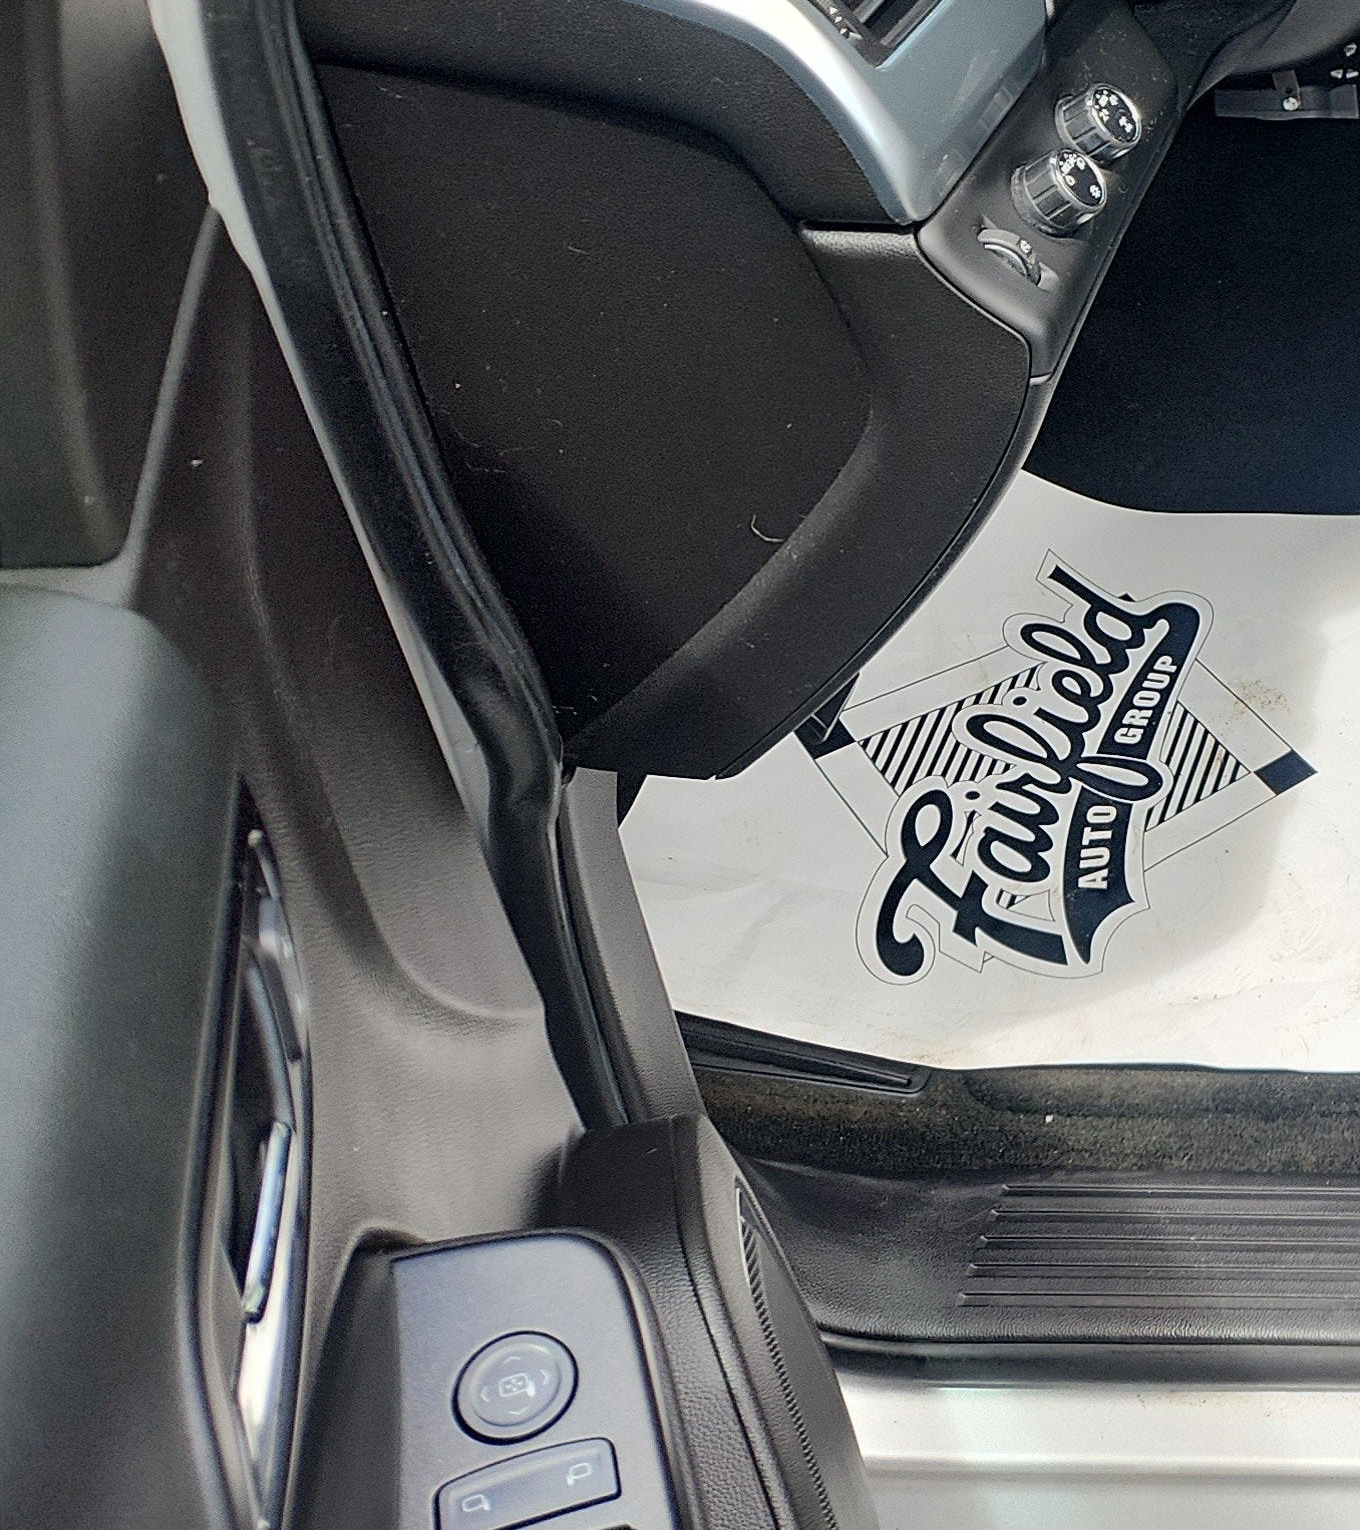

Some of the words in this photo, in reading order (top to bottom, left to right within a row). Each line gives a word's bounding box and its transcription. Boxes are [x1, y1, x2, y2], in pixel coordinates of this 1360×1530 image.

[876, 565, 1164, 976] Fairfield
[1078, 804, 1118, 890] AUTO
[1113, 654, 1179, 745] GROUP
